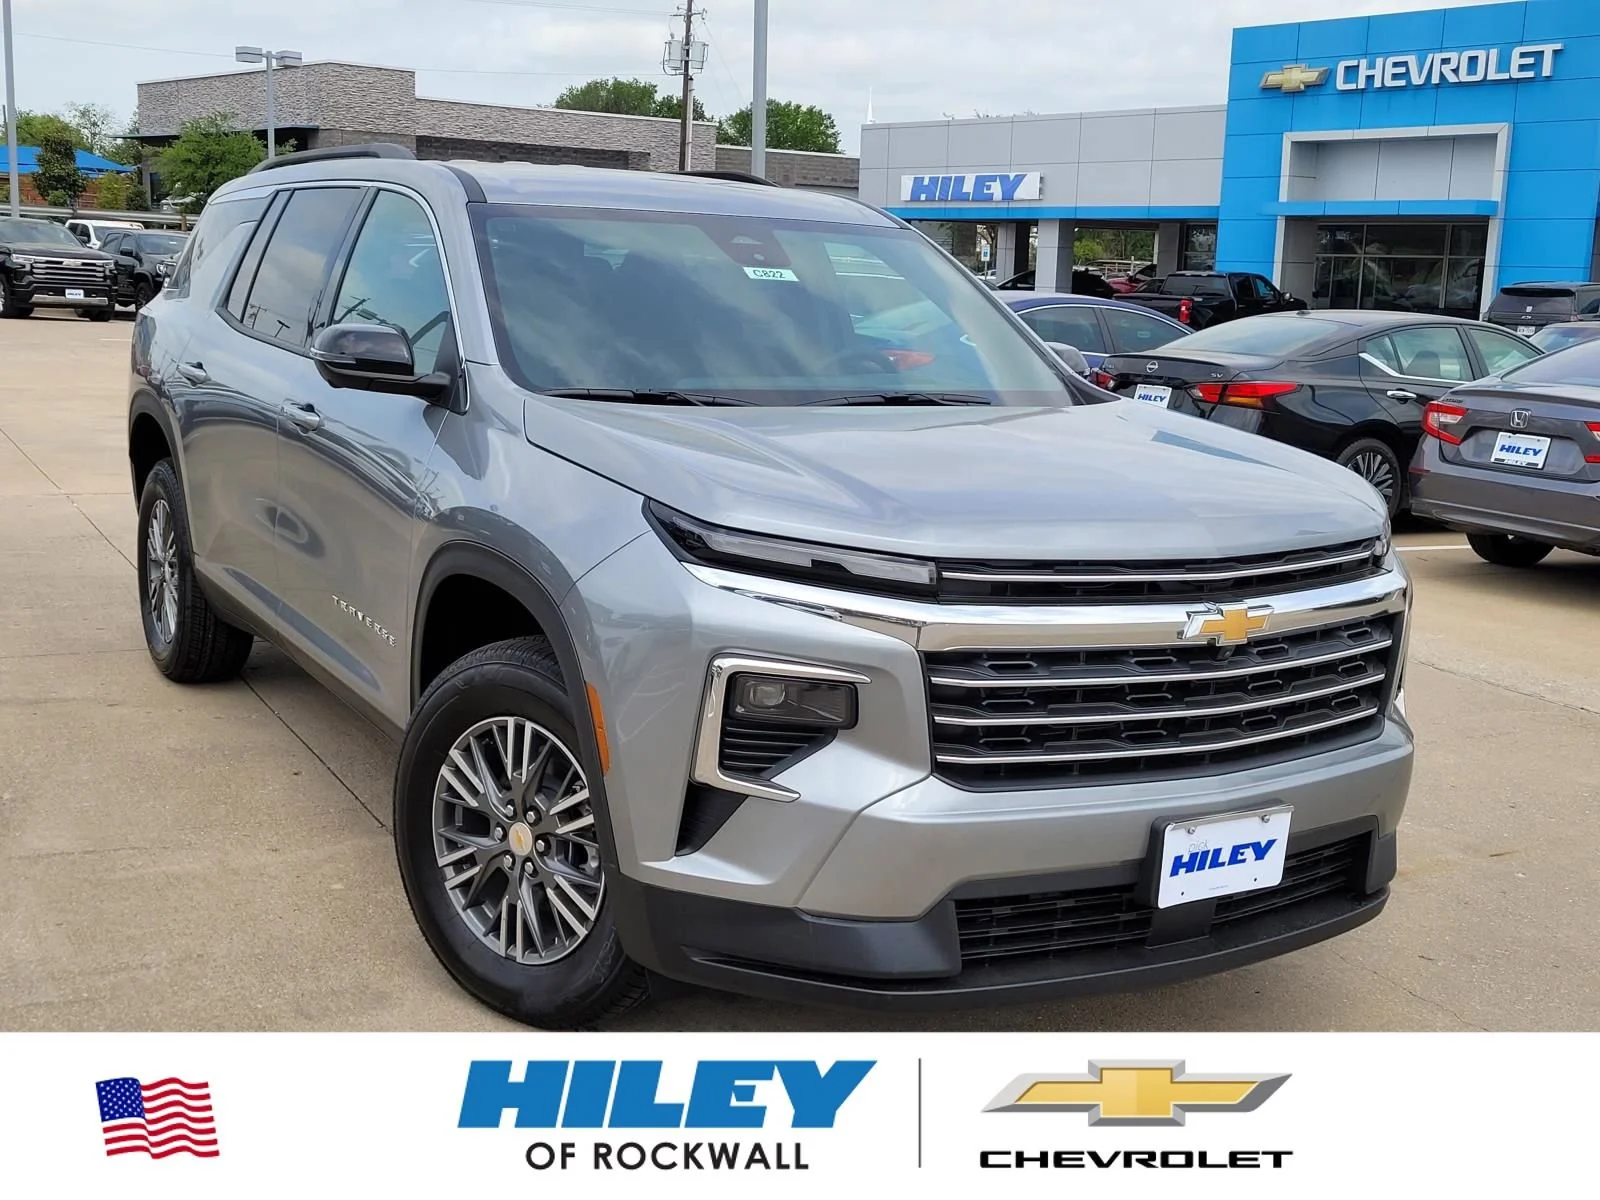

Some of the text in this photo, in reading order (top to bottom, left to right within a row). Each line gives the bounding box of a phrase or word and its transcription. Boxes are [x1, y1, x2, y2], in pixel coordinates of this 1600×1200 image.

[1336, 43, 1563, 91] CHEVROLET
[910, 173, 1028, 201] HILEY
[753, 269, 785, 279] C822
[1137, 393, 1167, 402] HILEY
[1499, 444, 1543, 457] HILEY
[331, 594, 397, 648] TRAVERSE
[1169, 838, 1278, 878] HILEY
